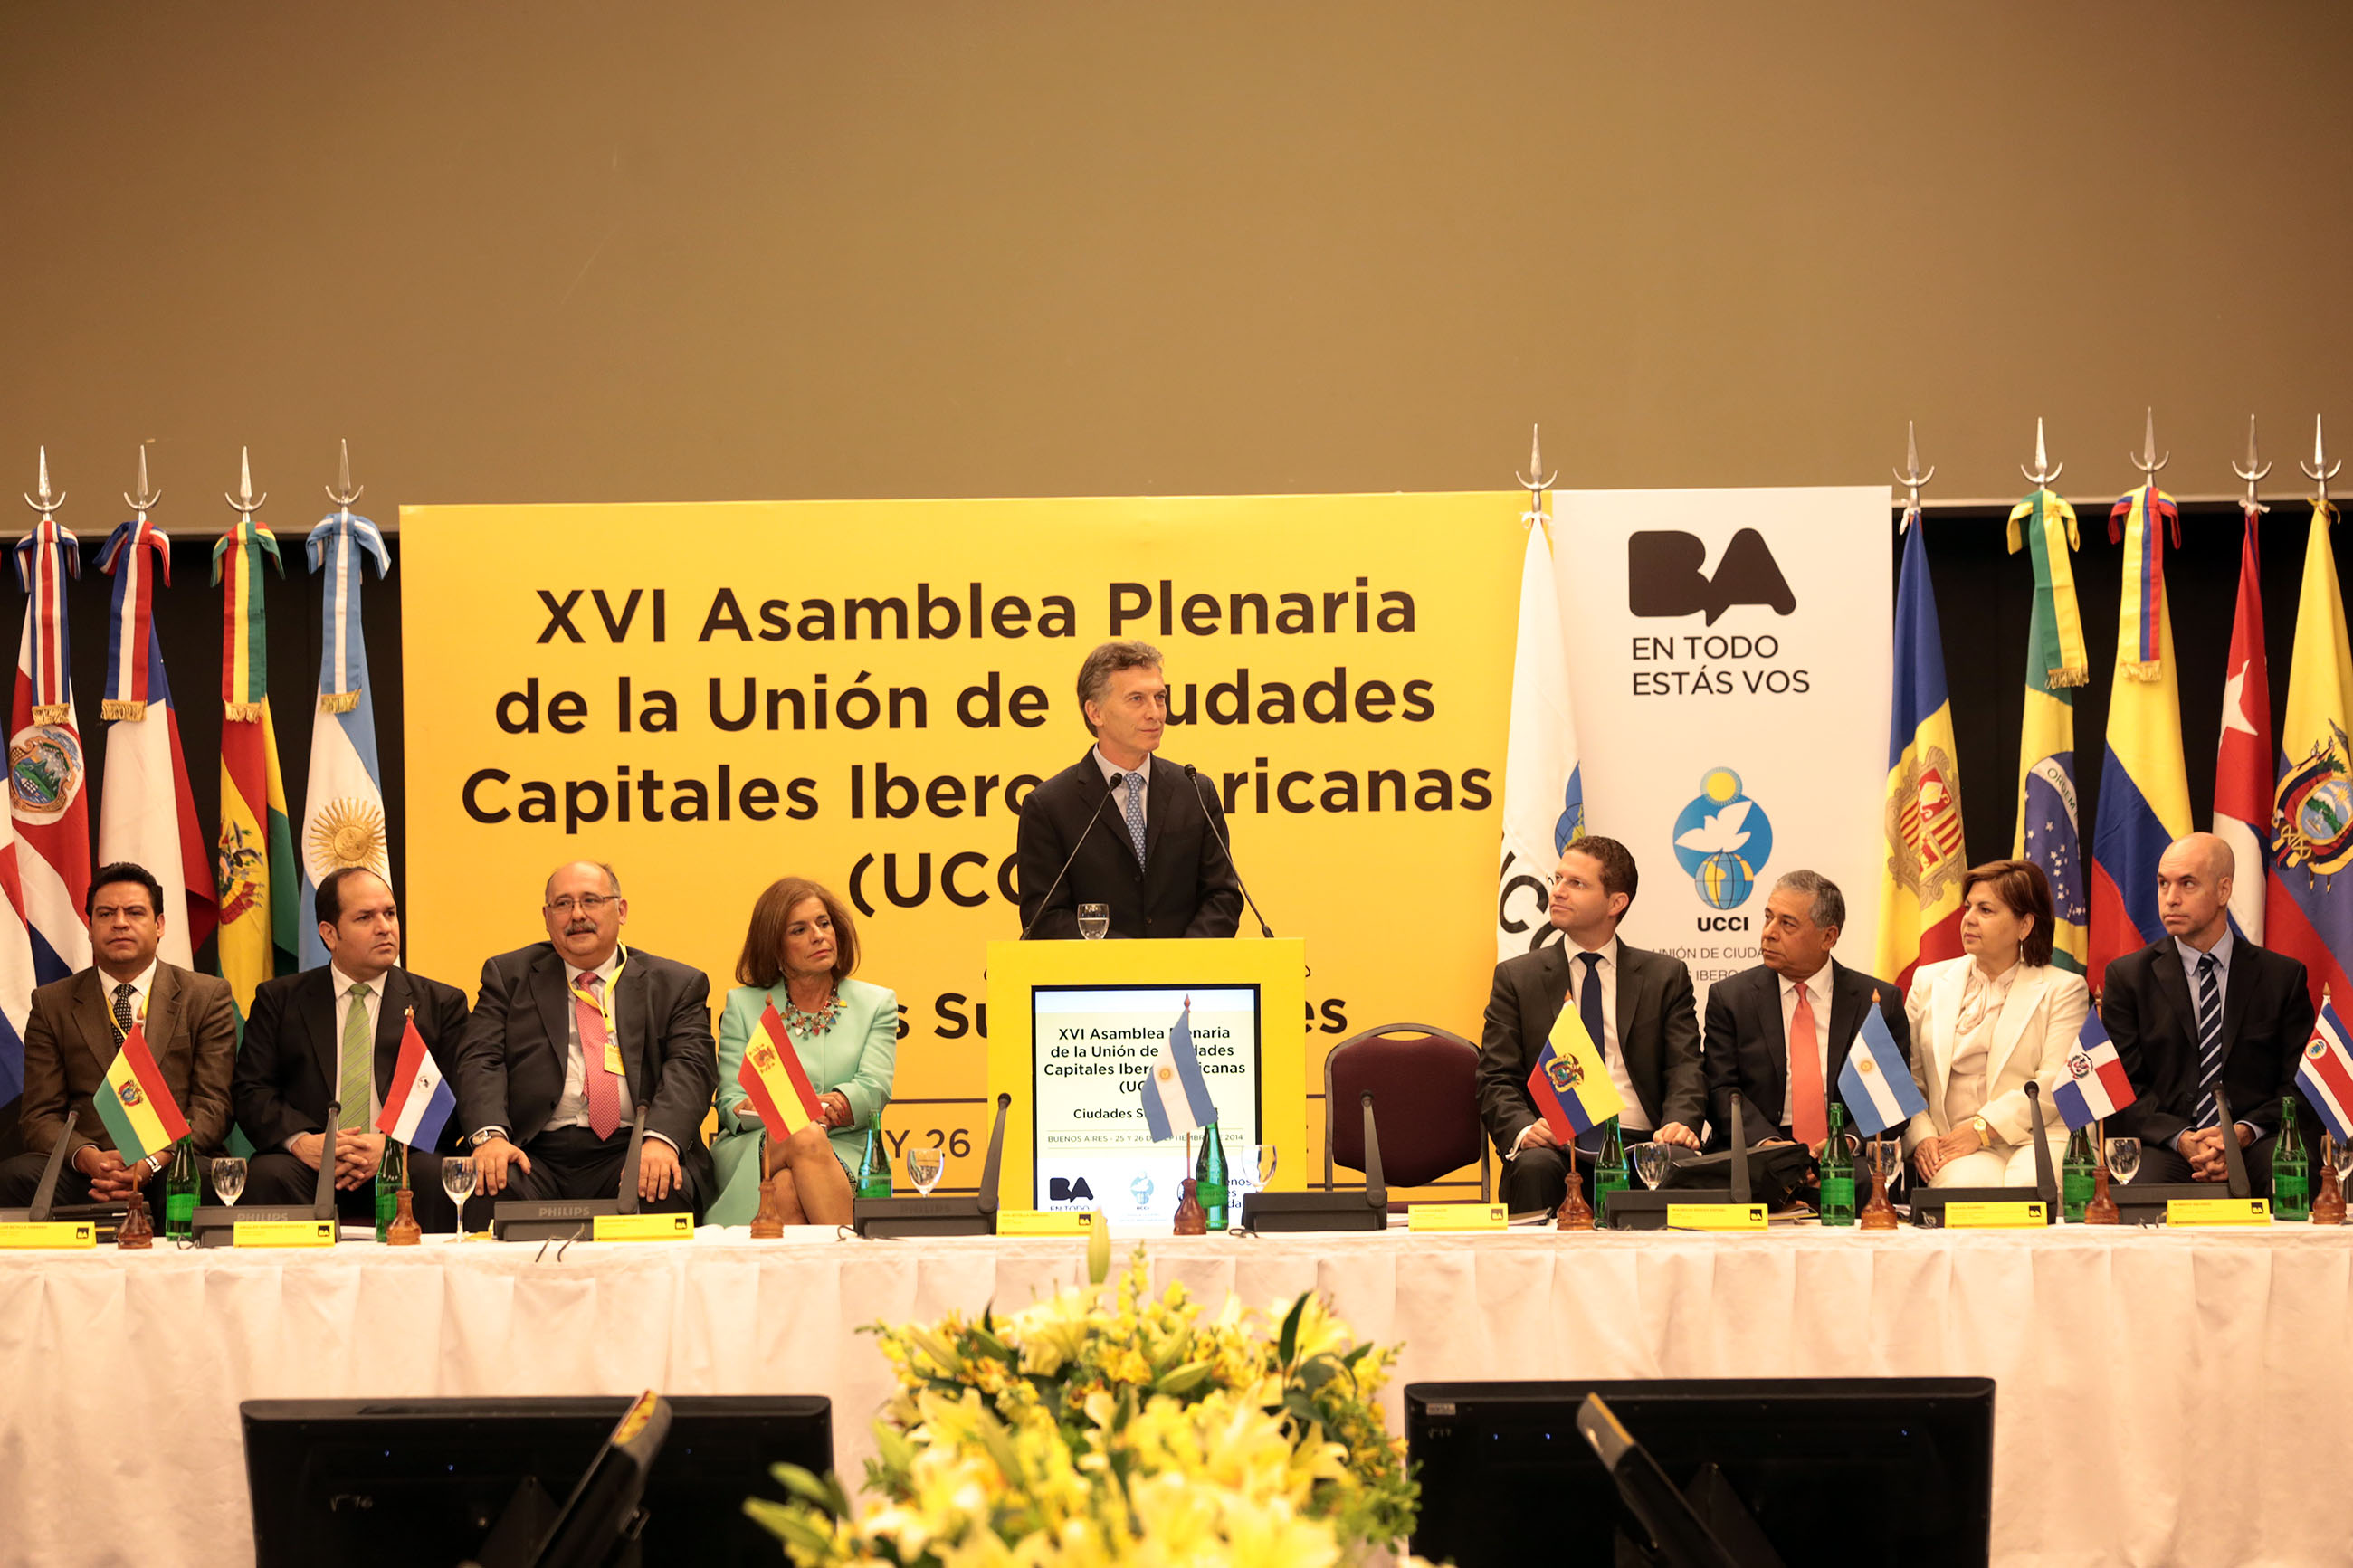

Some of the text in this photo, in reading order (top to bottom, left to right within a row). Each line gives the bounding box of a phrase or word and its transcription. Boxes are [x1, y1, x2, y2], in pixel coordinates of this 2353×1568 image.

[1628, 527, 1797, 628] BA
[536, 576, 1415, 644] XVI Asamblea Plenaria
[1633, 634, 1779, 660] EN TODO
[1633, 665, 1810, 696] ESTÁS VOS
[495, 666, 1434, 735] de la Unión de udades
[462, 764, 819, 835] Capitales
[1697, 917, 1749, 932] UCCI
[1700, 947, 1720, 959] DE
[1722, 946, 1763, 959] CIUDA
[1059, 1028, 1084, 1041] XVI
[1090, 1027, 1165, 1040] Asamblea
[1050, 1046, 1070, 1059] de
[1073, 1046, 1087, 1058] la
[1091, 1044, 1136, 1058] Unión
[1139, 1044, 1159, 1057] de
[1043, 1062, 1115, 1078] Capitales
[1073, 1108, 1132, 1119] Ciudades
[885, 1128, 971, 1159] Y 26
[1049, 1176, 1094, 1203] BA
[237, 1212, 289, 1221] PHILIPS
[538, 1206, 590, 1217] PHILIPS
